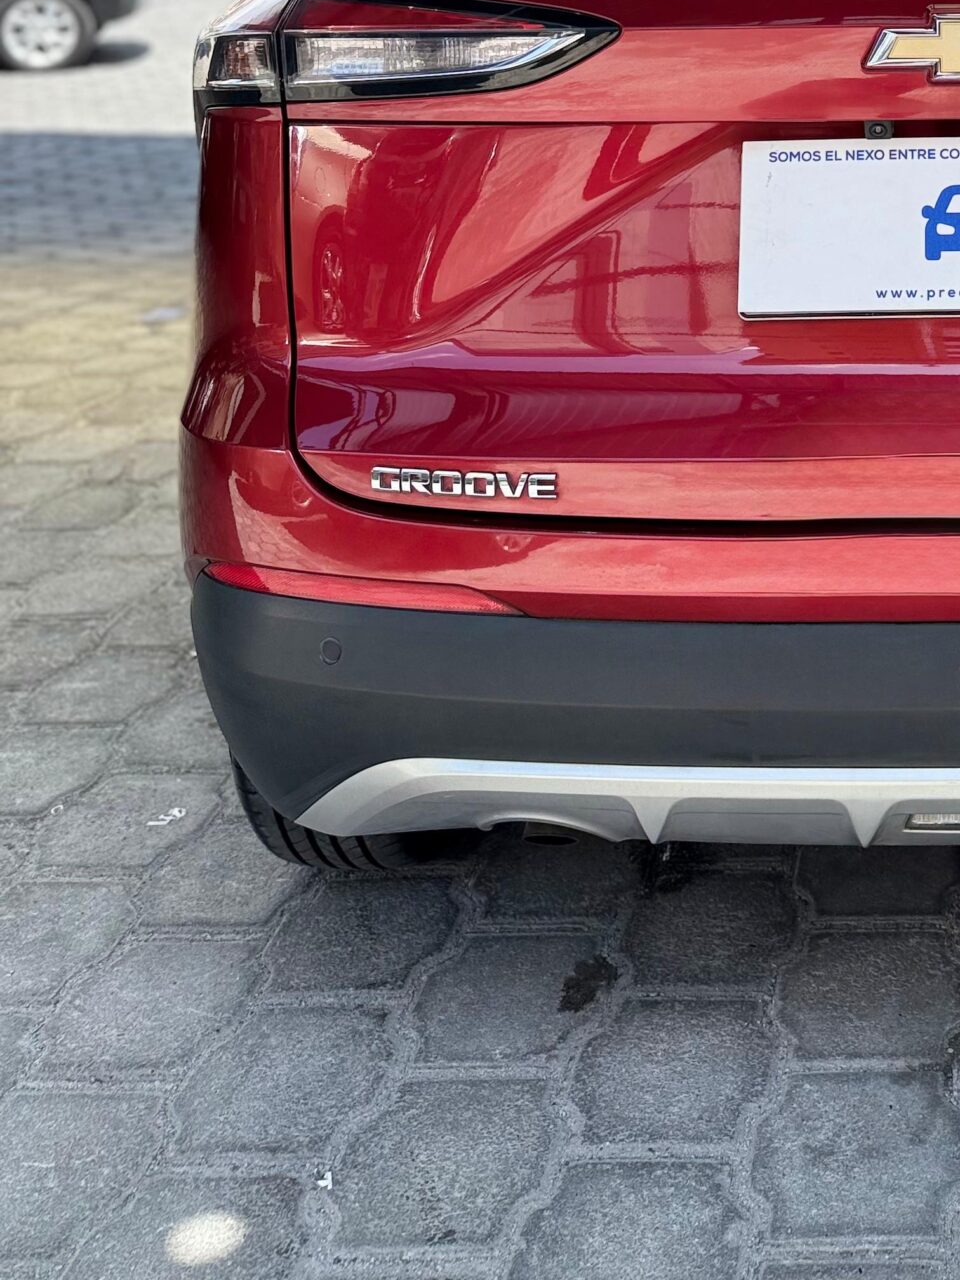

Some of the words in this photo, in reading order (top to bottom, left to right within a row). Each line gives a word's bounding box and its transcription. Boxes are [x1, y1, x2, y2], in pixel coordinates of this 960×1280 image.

[769, 150, 822, 163] SOMOS
[825, 150, 843, 162] EL
[845, 149, 885, 161] NEXO
[888, 149, 936, 160] ENTRE
[370, 466, 557, 500] GROOVE
